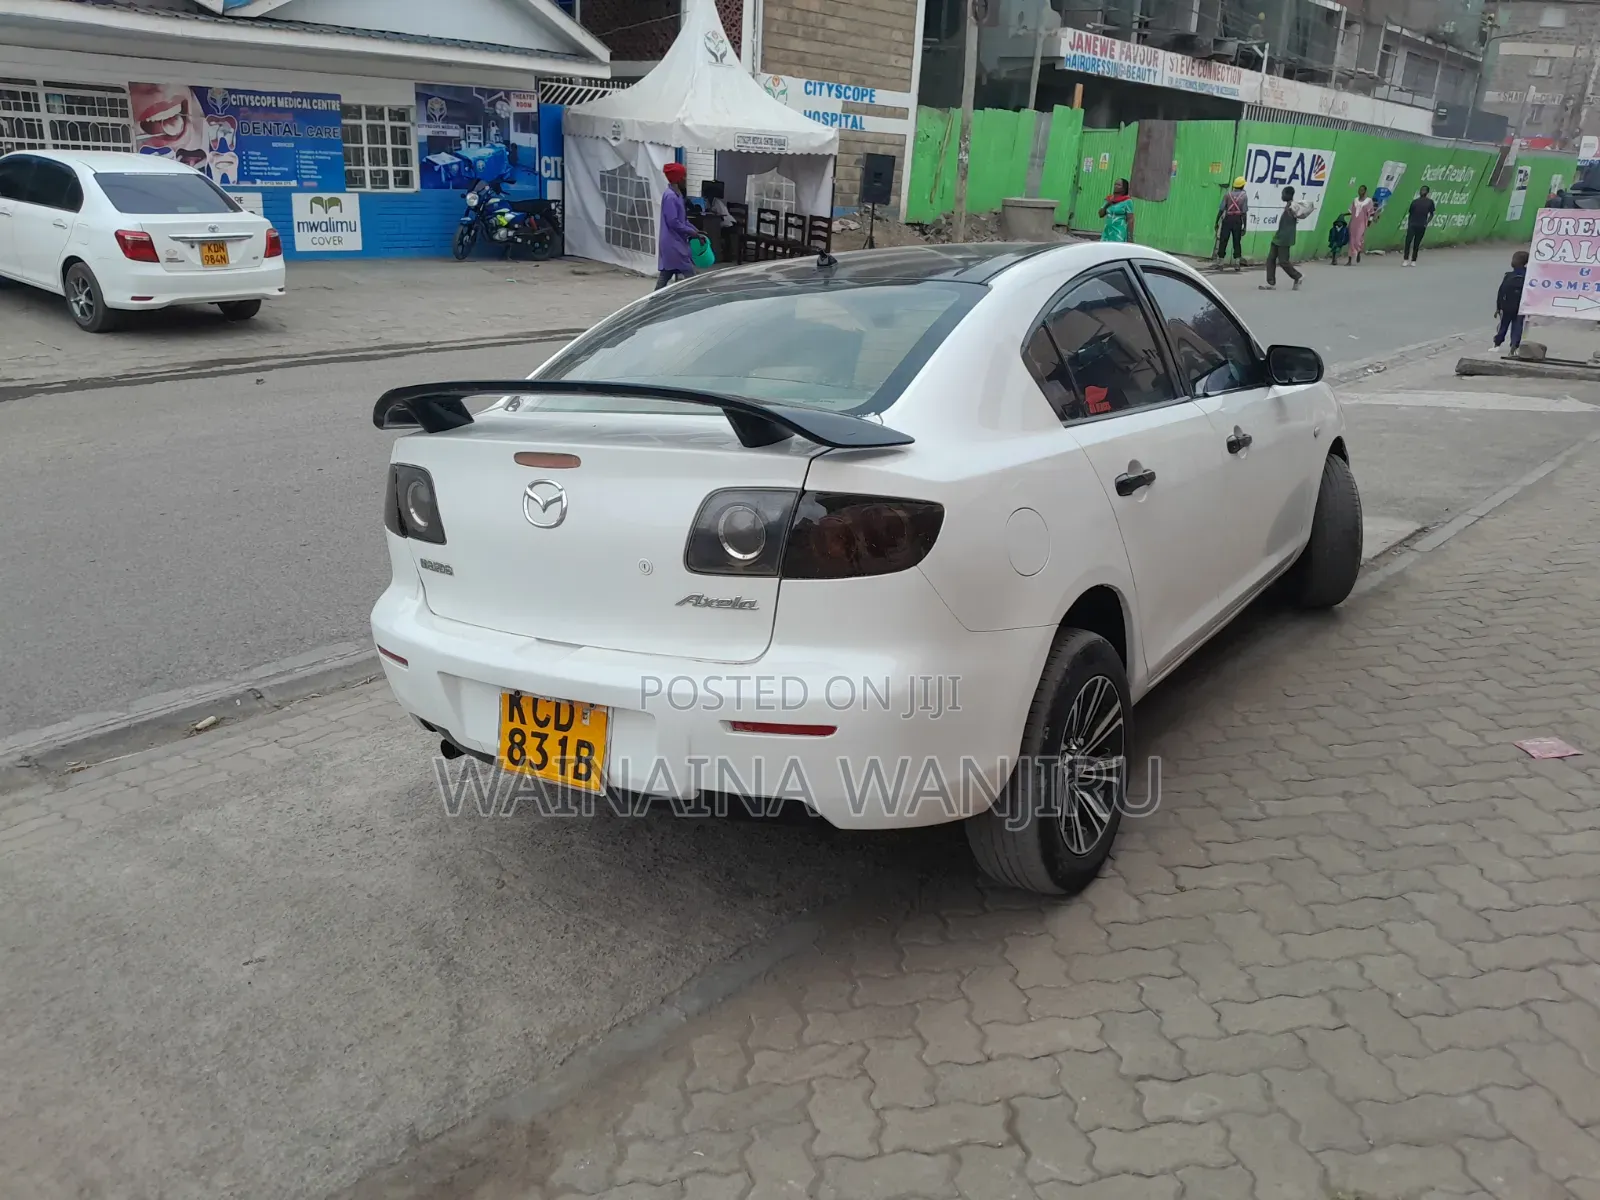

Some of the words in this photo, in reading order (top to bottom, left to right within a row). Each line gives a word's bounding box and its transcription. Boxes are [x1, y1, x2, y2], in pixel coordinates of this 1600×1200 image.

[1069, 31, 1116, 59] JANEWE
[1120, 42, 1159, 67] FAVOUR
[1127, 64, 1158, 84] BEAUTY
[1169, 55, 1195, 77] STEVE
[1197, 60, 1242, 86] CONNECTION
[804, 80, 876, 103] CITYSCOPE
[230, 94, 276, 108] CITYSCOPE
[277, 96, 311, 110] MEDICAL
[312, 99, 341, 111] CENTRE
[240, 121, 302, 137] DENTAL
[306, 126, 341, 139] CARE
[1245, 149, 1325, 187] IDEAL
[297, 216, 357, 233] mwalimu
[207, 242, 225, 253] KDN
[311, 236, 343, 246] COVER
[1535, 238, 1600, 264] SAL
[204, 254, 227, 265] 984N
[1579, 267, 1592, 277] &
[674, 591, 760, 611] Axela
[508, 693, 575, 733] KCD
[507, 727, 596, 783] 831B
